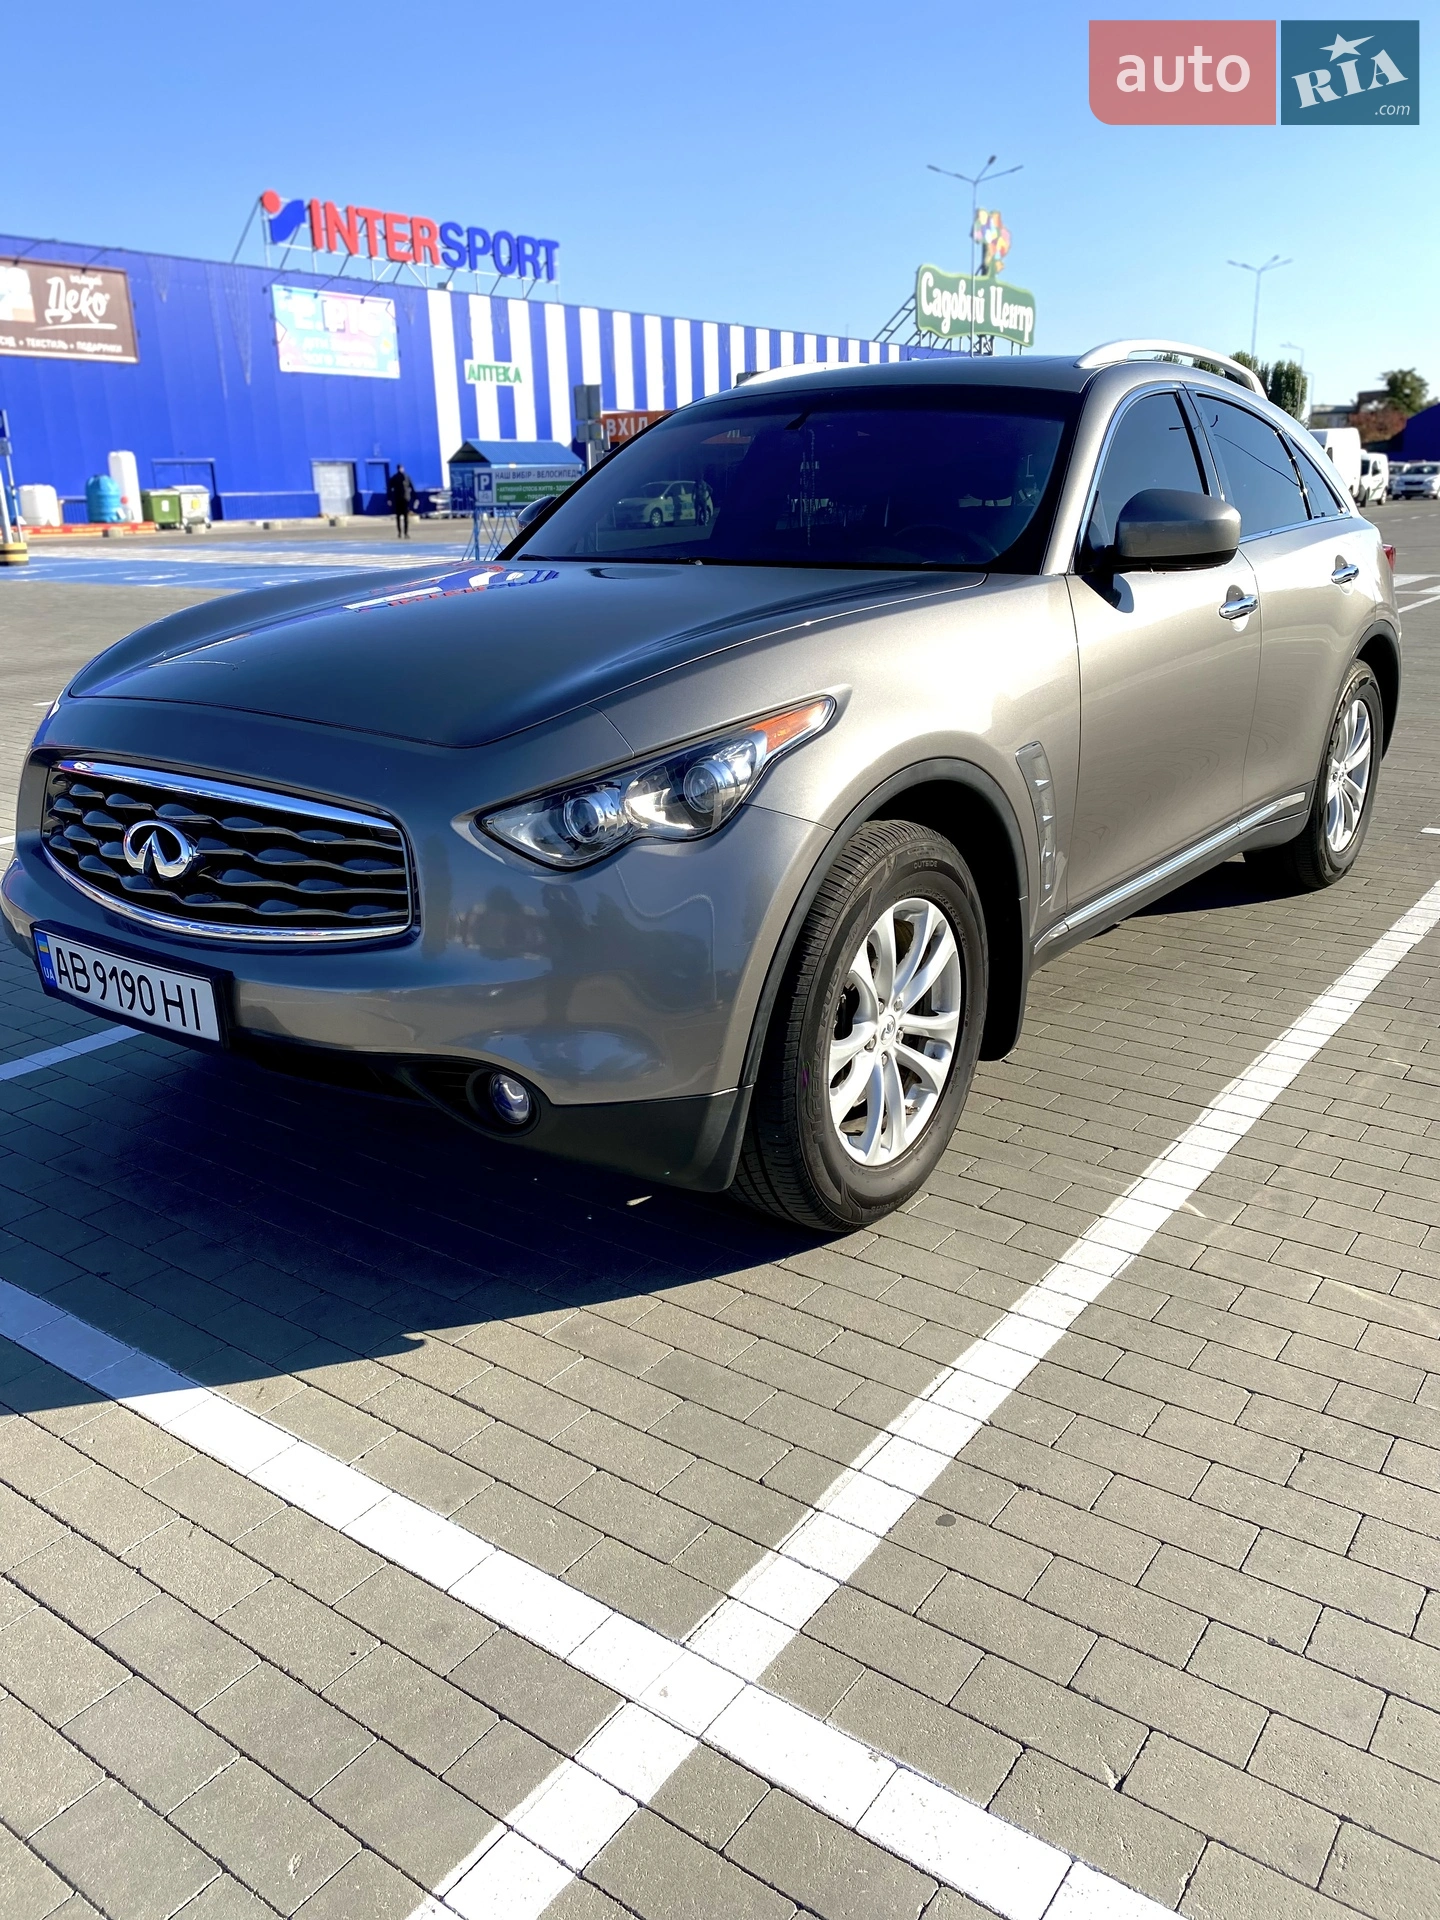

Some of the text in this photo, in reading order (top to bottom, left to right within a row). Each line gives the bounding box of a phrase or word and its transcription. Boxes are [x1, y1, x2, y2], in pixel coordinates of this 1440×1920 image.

[309, 197, 560, 282] INTERSPORT
[44, 276, 108, 324] Деко
[989, 285, 1034, 343] Центр
[467, 364, 522, 384] АПТЕКА
[495, 471, 511, 480] НАШ
[512, 470, 532, 480] ВИБІР
[43, 965, 55, 981] UA
[55, 946, 201, 1031] AB 9190 HI
